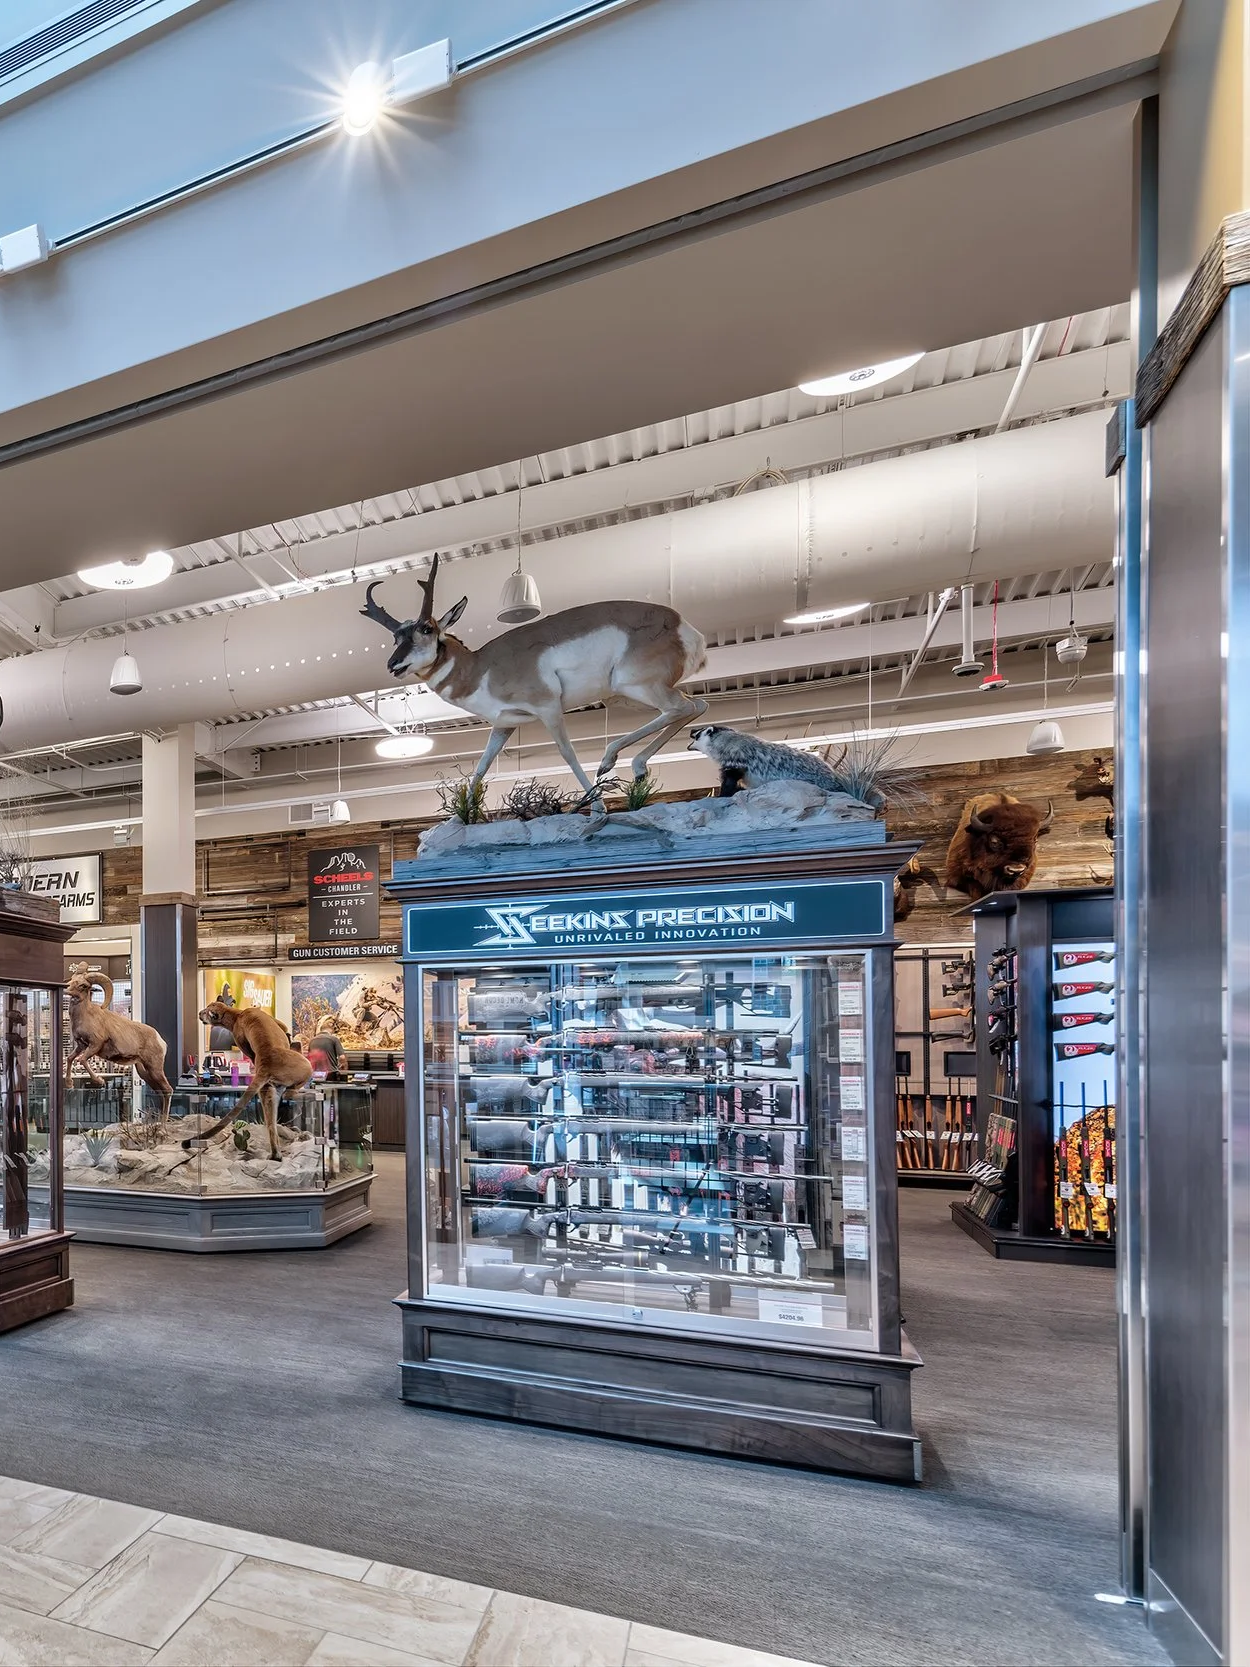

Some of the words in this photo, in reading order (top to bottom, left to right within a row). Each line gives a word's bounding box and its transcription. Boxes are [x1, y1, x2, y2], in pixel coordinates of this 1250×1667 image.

[313, 871, 375, 884] SCHEELS
[327, 883, 361, 893] CHANDLER
[46, 892, 96, 909] ARMS
[321, 898, 366, 908] EXPERTS
[472, 903, 634, 947] SEEKINS
[635, 900, 796, 928] PRECISION
[329, 927, 358, 935] FIELD
[554, 930, 645, 944] UNRIVALED
[654, 926, 761, 941] INNOVATION
[293, 948, 311, 958] GUN
[313, 946, 360, 957] CUSTOMER
[361, 944, 398, 955] SERVICE
